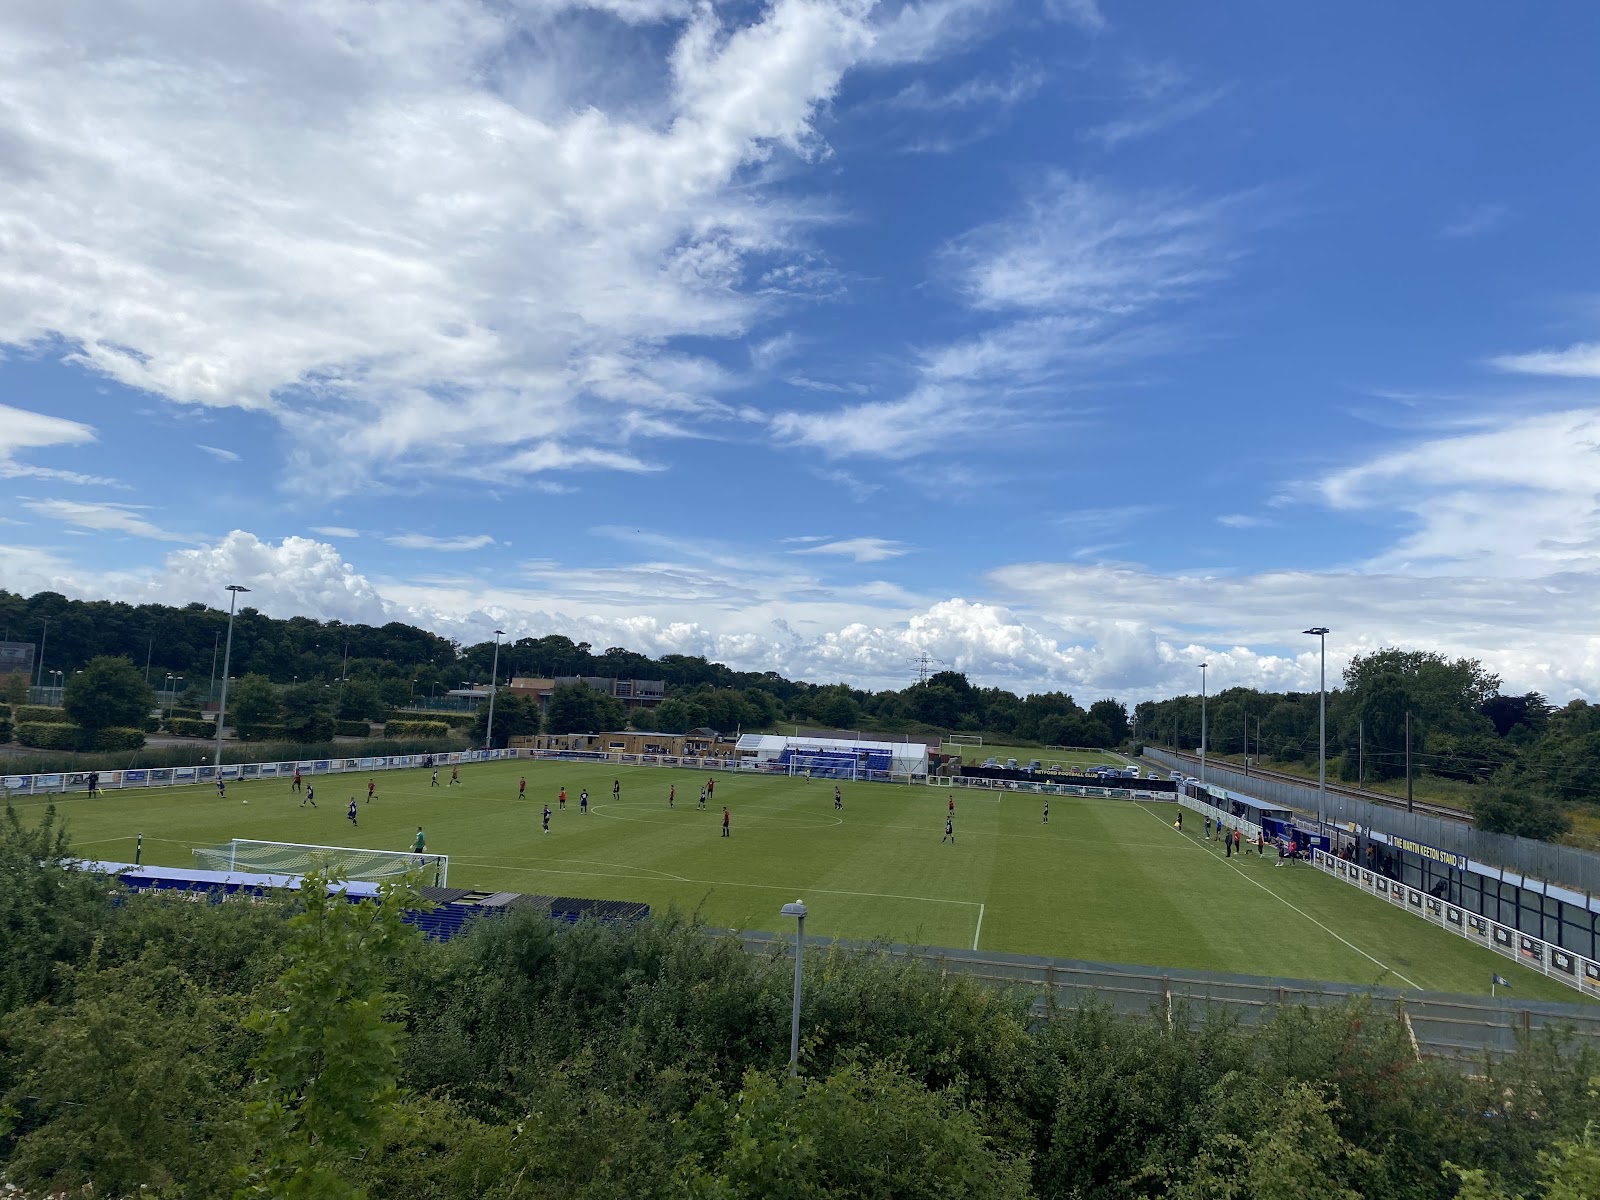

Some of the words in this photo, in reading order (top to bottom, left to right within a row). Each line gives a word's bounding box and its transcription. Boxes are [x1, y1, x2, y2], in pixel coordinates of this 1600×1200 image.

[1394, 836, 1402, 849] THE
[1402, 839, 1420, 855] MARTIN
[1420, 844, 1440, 861] KEETON
[1440, 851, 1457, 867] STAND
